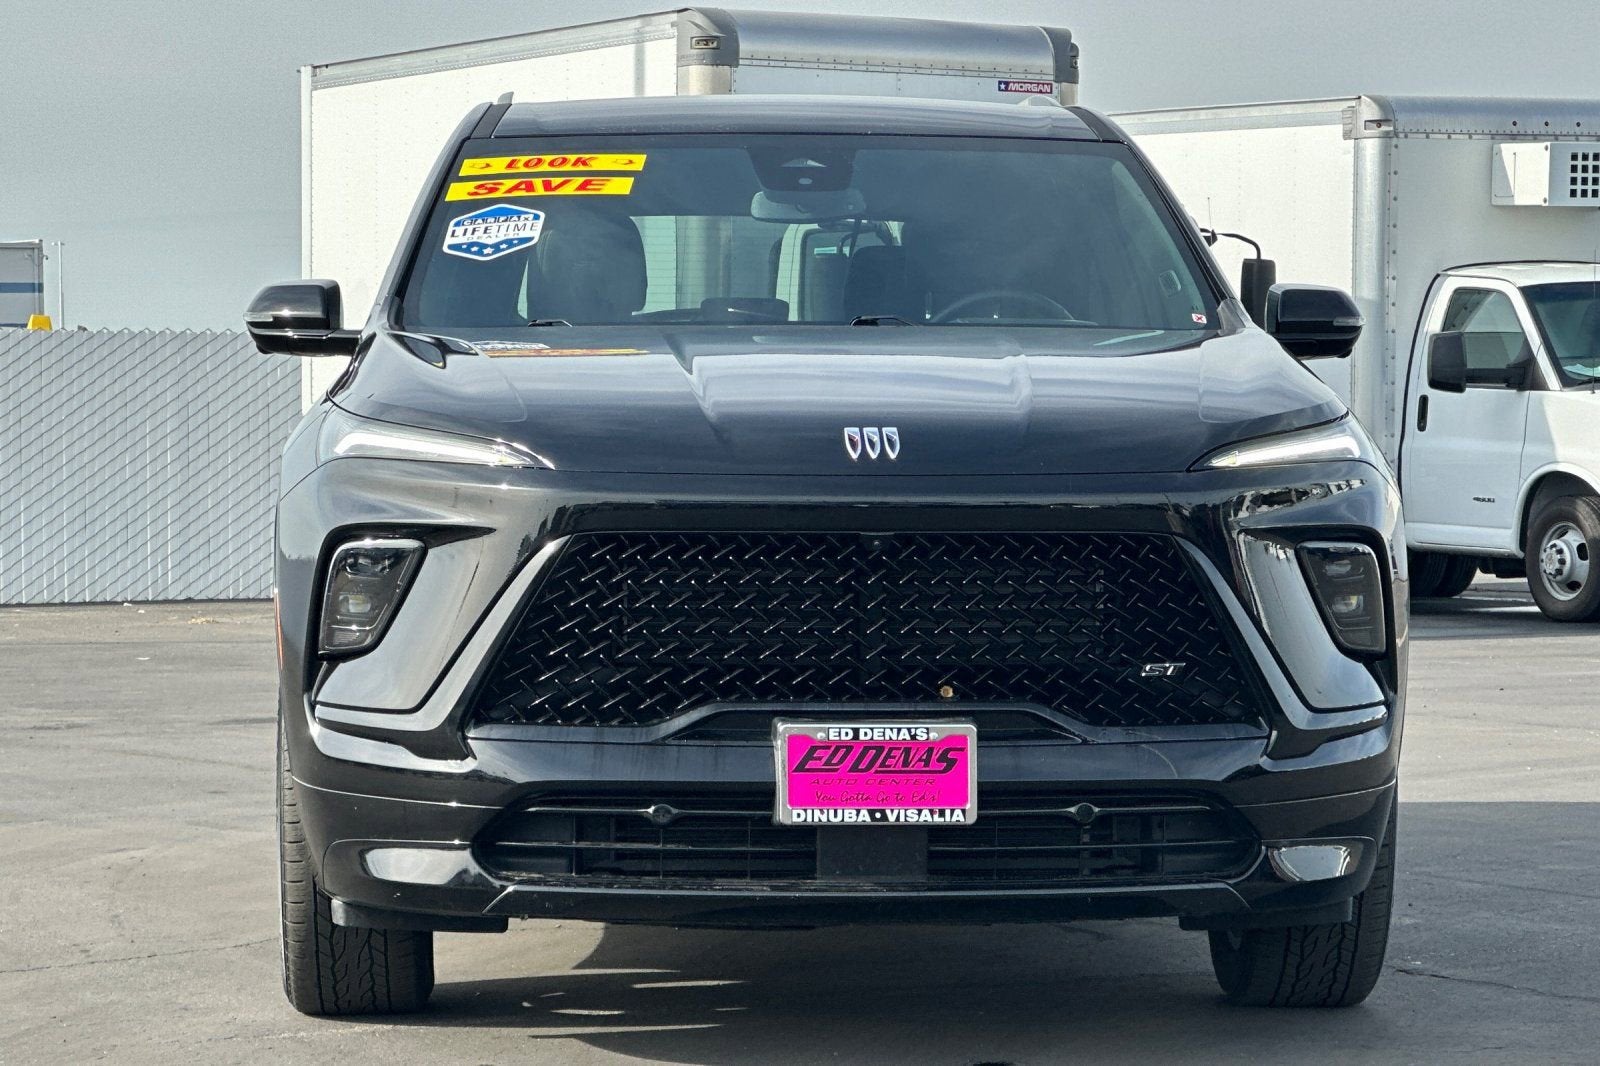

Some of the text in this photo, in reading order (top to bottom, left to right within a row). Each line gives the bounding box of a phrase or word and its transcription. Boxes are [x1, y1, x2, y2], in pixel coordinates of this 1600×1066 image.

[1008, 83, 1051, 93] MORGAN
[505, 156, 598, 170] LOOK
[467, 178, 611, 196] SAVE
[450, 222, 539, 238] LIFETIME
[828, 728, 928, 740] ED DENA'S
[792, 745, 967, 775] ED DENA'S
[816, 791, 836, 802] You
[841, 791, 872, 802] Gotta
[877, 791, 889, 802] Go
[895, 792, 906, 801] to
[792, 809, 965, 822] DINUBA VISALIA
